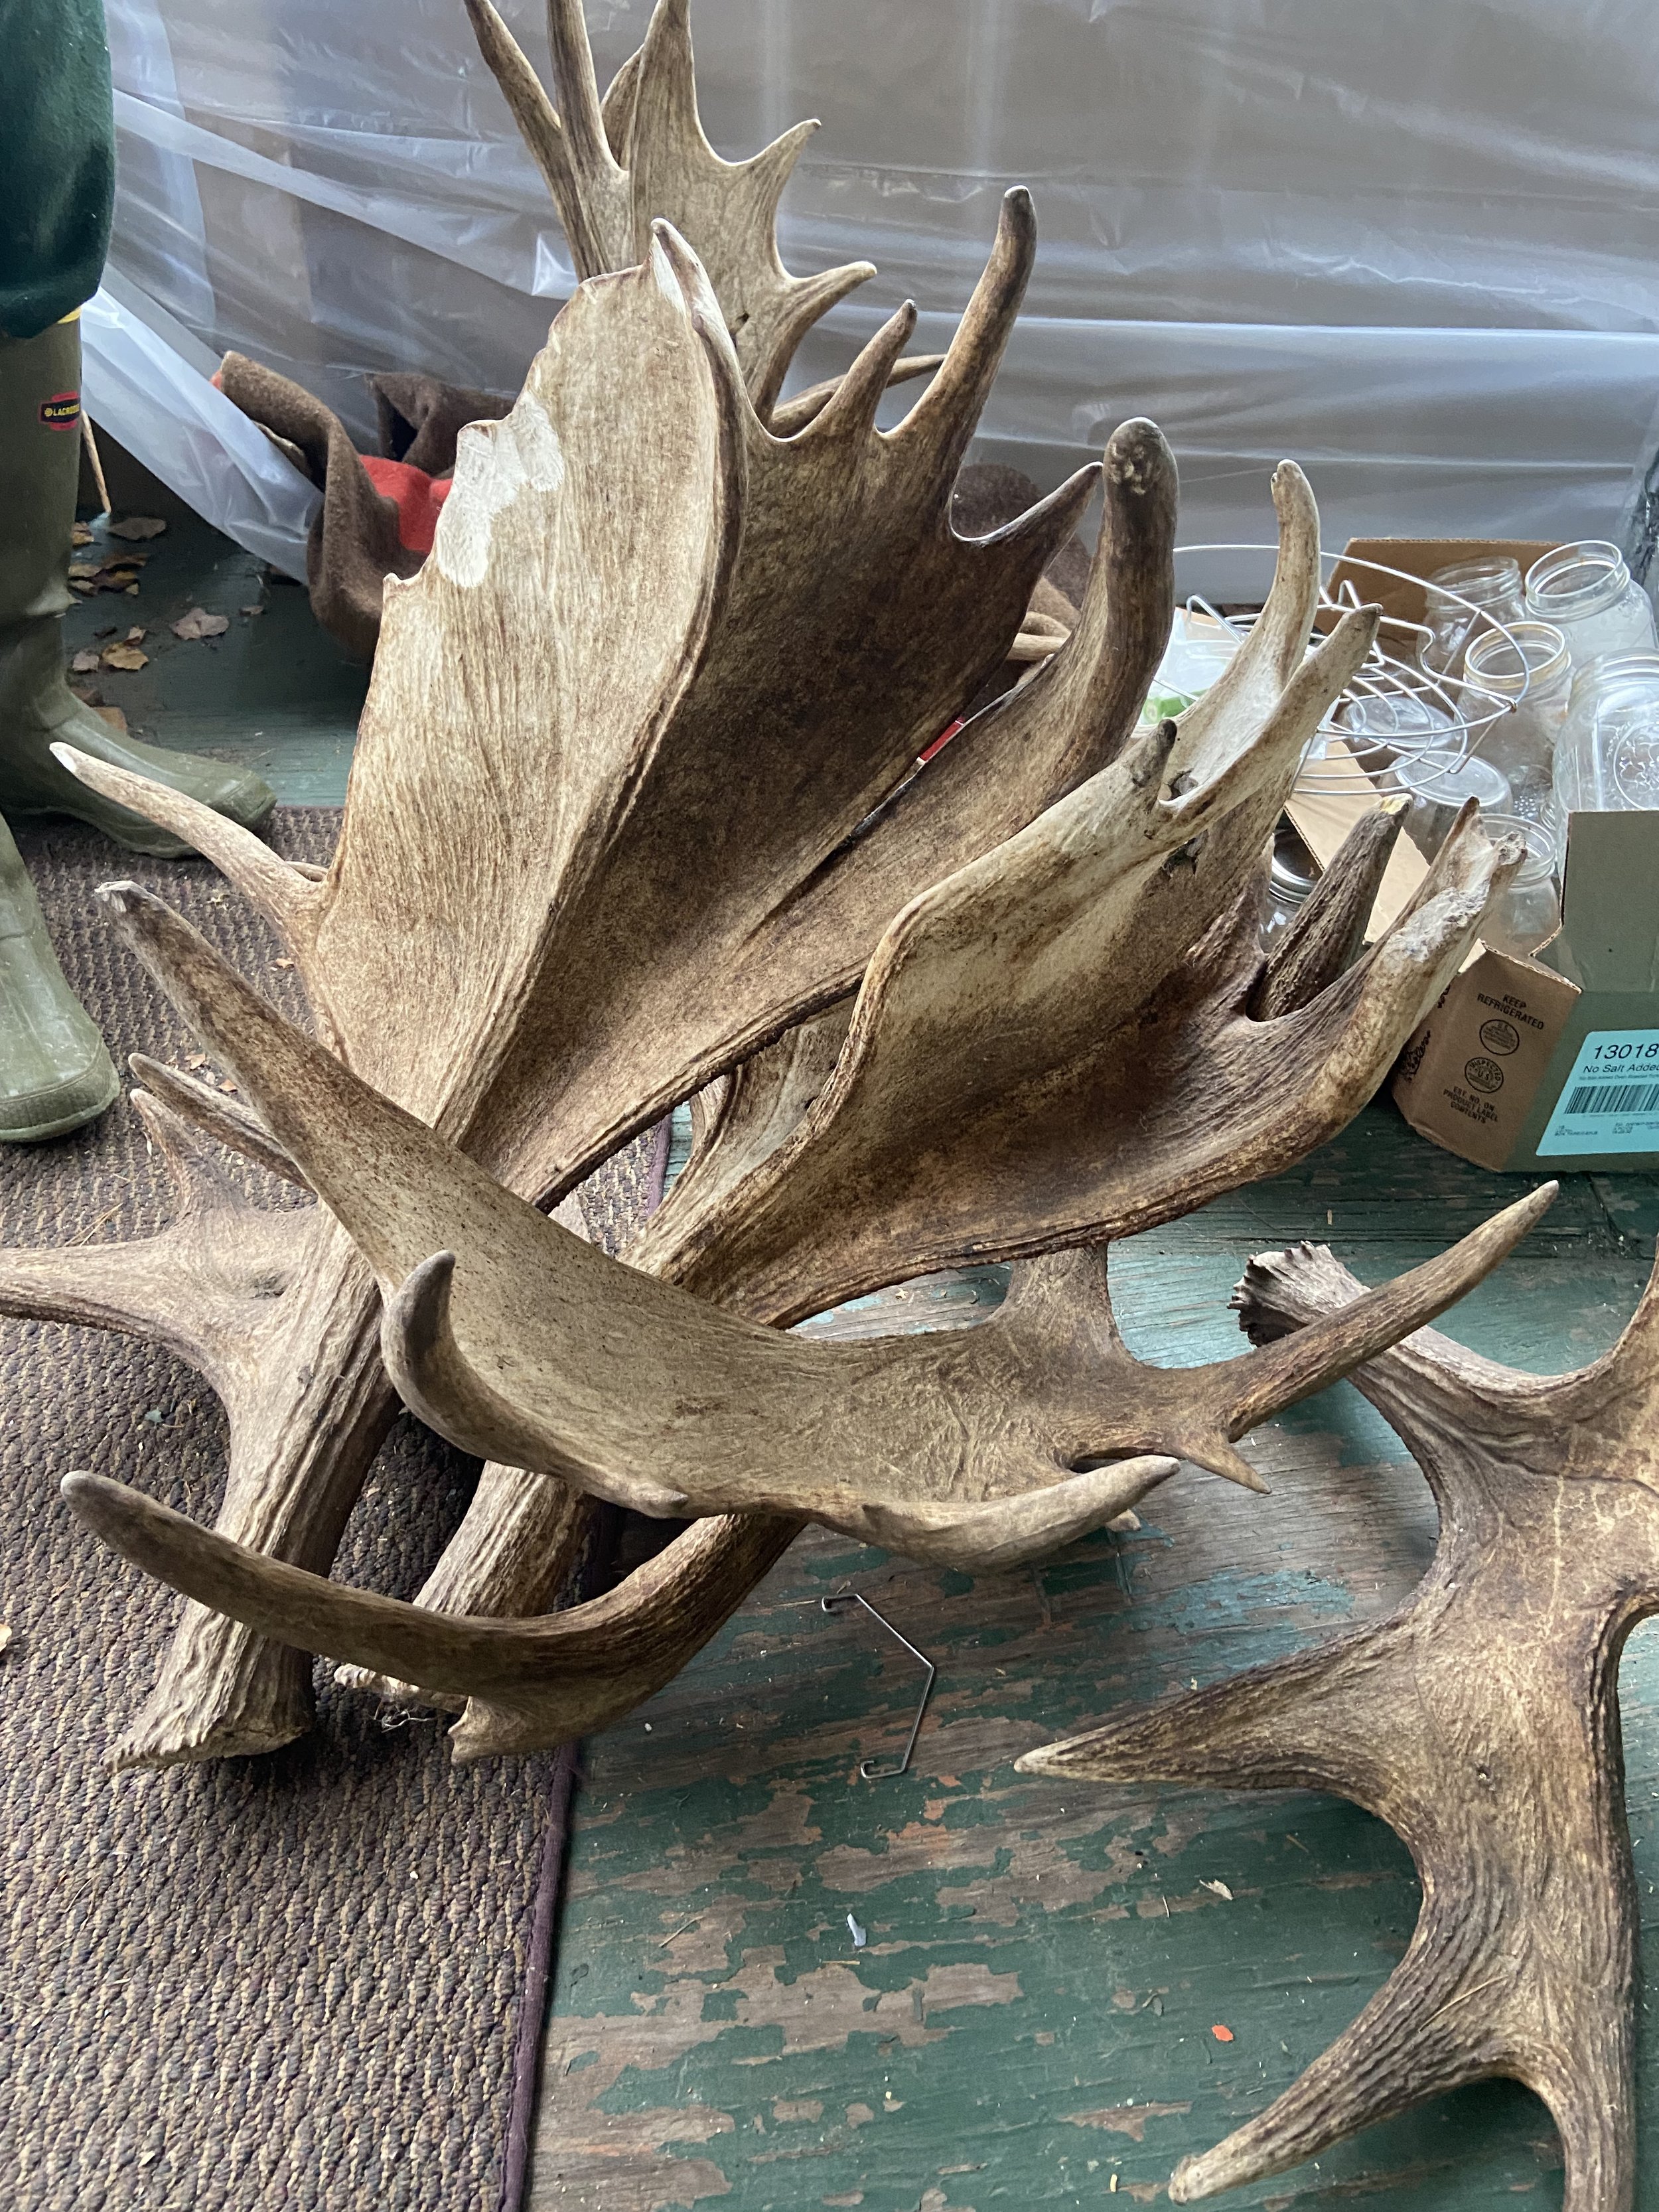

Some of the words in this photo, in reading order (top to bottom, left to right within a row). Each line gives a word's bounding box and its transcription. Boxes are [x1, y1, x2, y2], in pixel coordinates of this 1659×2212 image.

[1503, 994, 1526, 1009] KEEP
[1477, 993, 1544, 1030] REFRIGERATED
[1595, 1043, 1659, 1059] 13018
[1603, 1064, 1624, 1072] Salt
